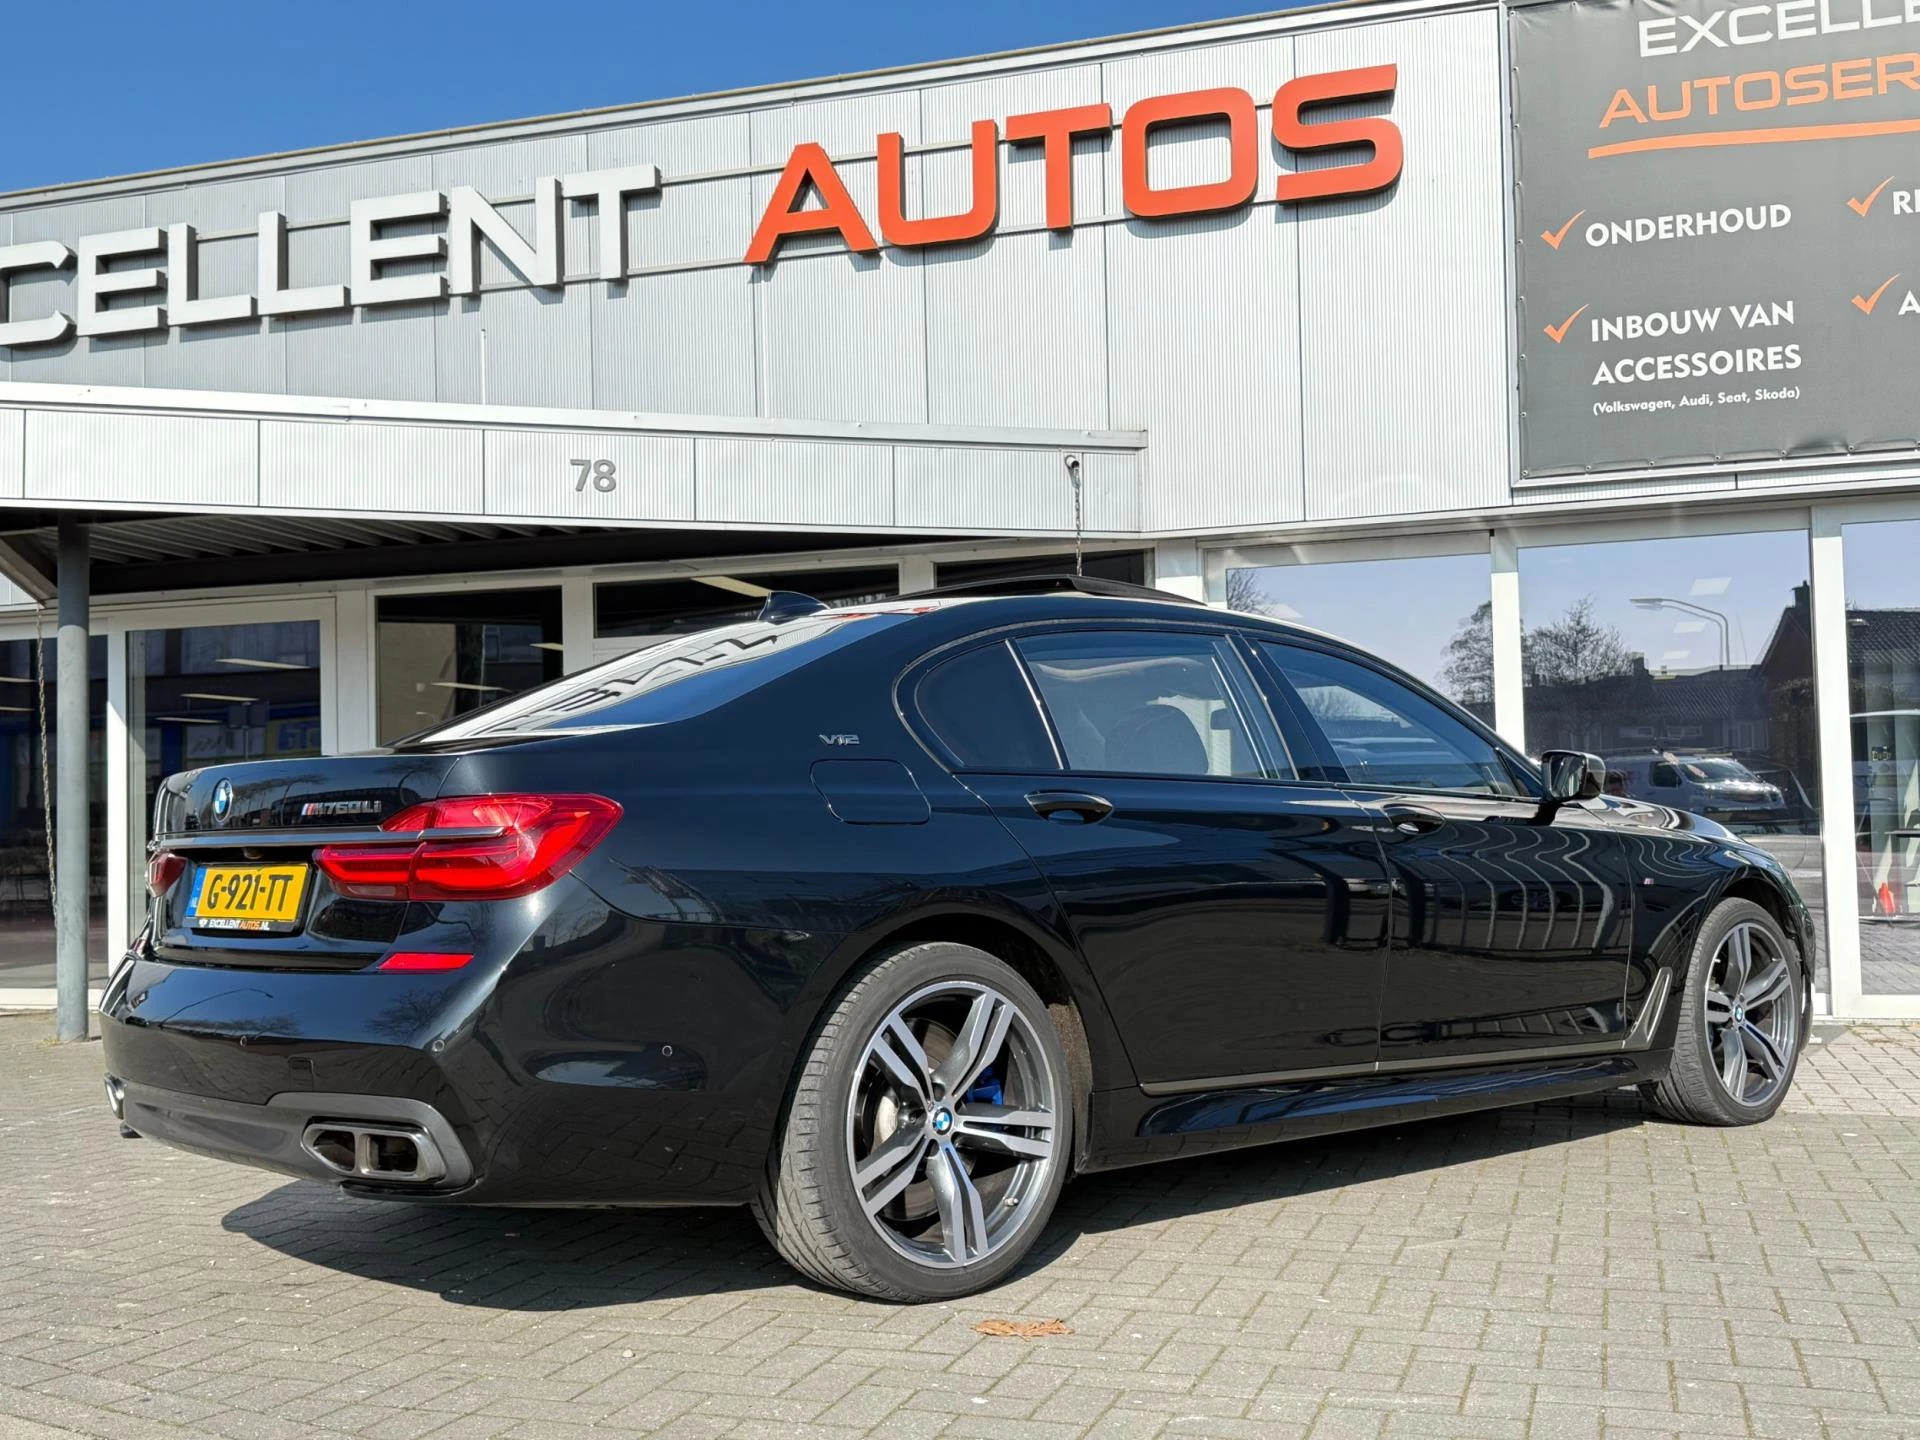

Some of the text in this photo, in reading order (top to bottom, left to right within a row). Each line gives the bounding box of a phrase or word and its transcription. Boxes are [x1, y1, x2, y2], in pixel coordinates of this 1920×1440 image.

[1599, 52, 1920, 128] AUTOSER
[743, 63, 1403, 266] AUTOS
[1585, 204, 1792, 247] ONDERHOUD
[1591, 301, 1794, 342] INBOUW VAN
[1592, 344, 1802, 385] ACCESSOIRES
[1593, 386, 1800, 416] (Volkswagen, Audi, Seat, Skoda)
[570, 459, 617, 492] 78
[818, 734, 860, 745] V12
[207, 873, 294, 912] G-921-TT
